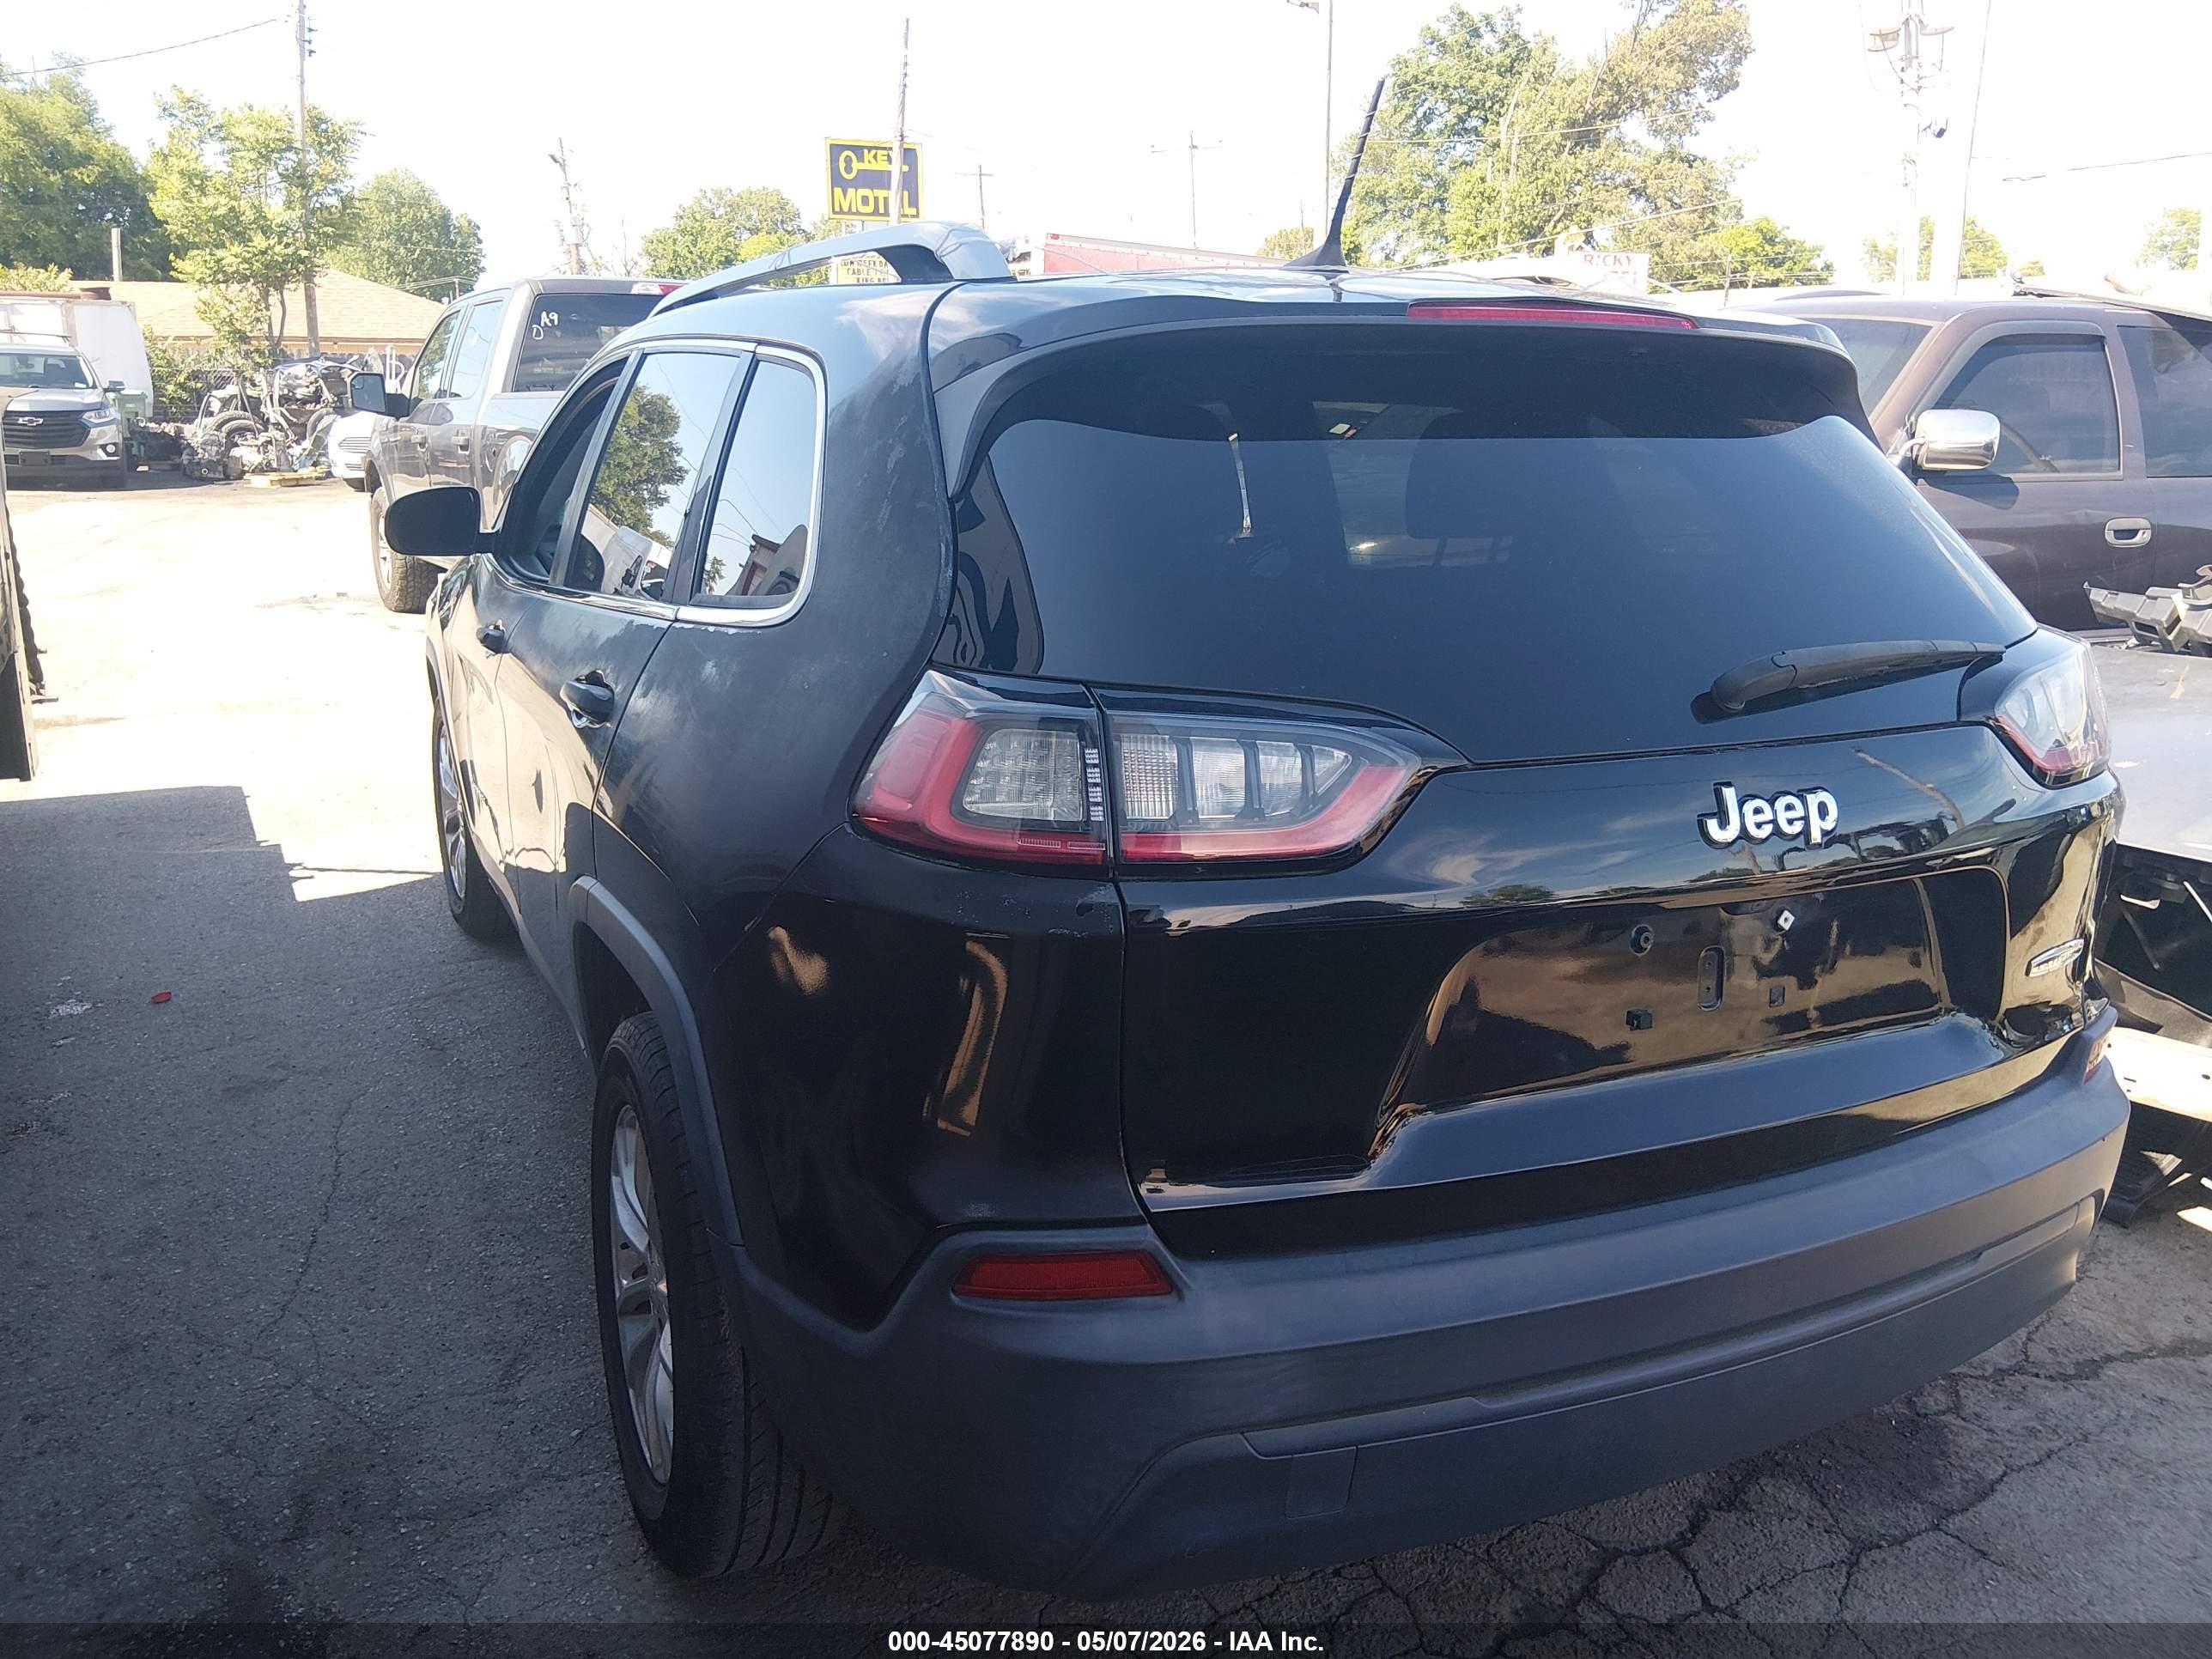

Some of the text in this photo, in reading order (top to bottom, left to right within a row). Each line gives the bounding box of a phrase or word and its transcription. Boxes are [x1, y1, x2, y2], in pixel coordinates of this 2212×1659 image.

[863, 149, 895, 165] KE
[833, 186, 917, 216] MOTL
[1698, 781, 1838, 848] Jeep
